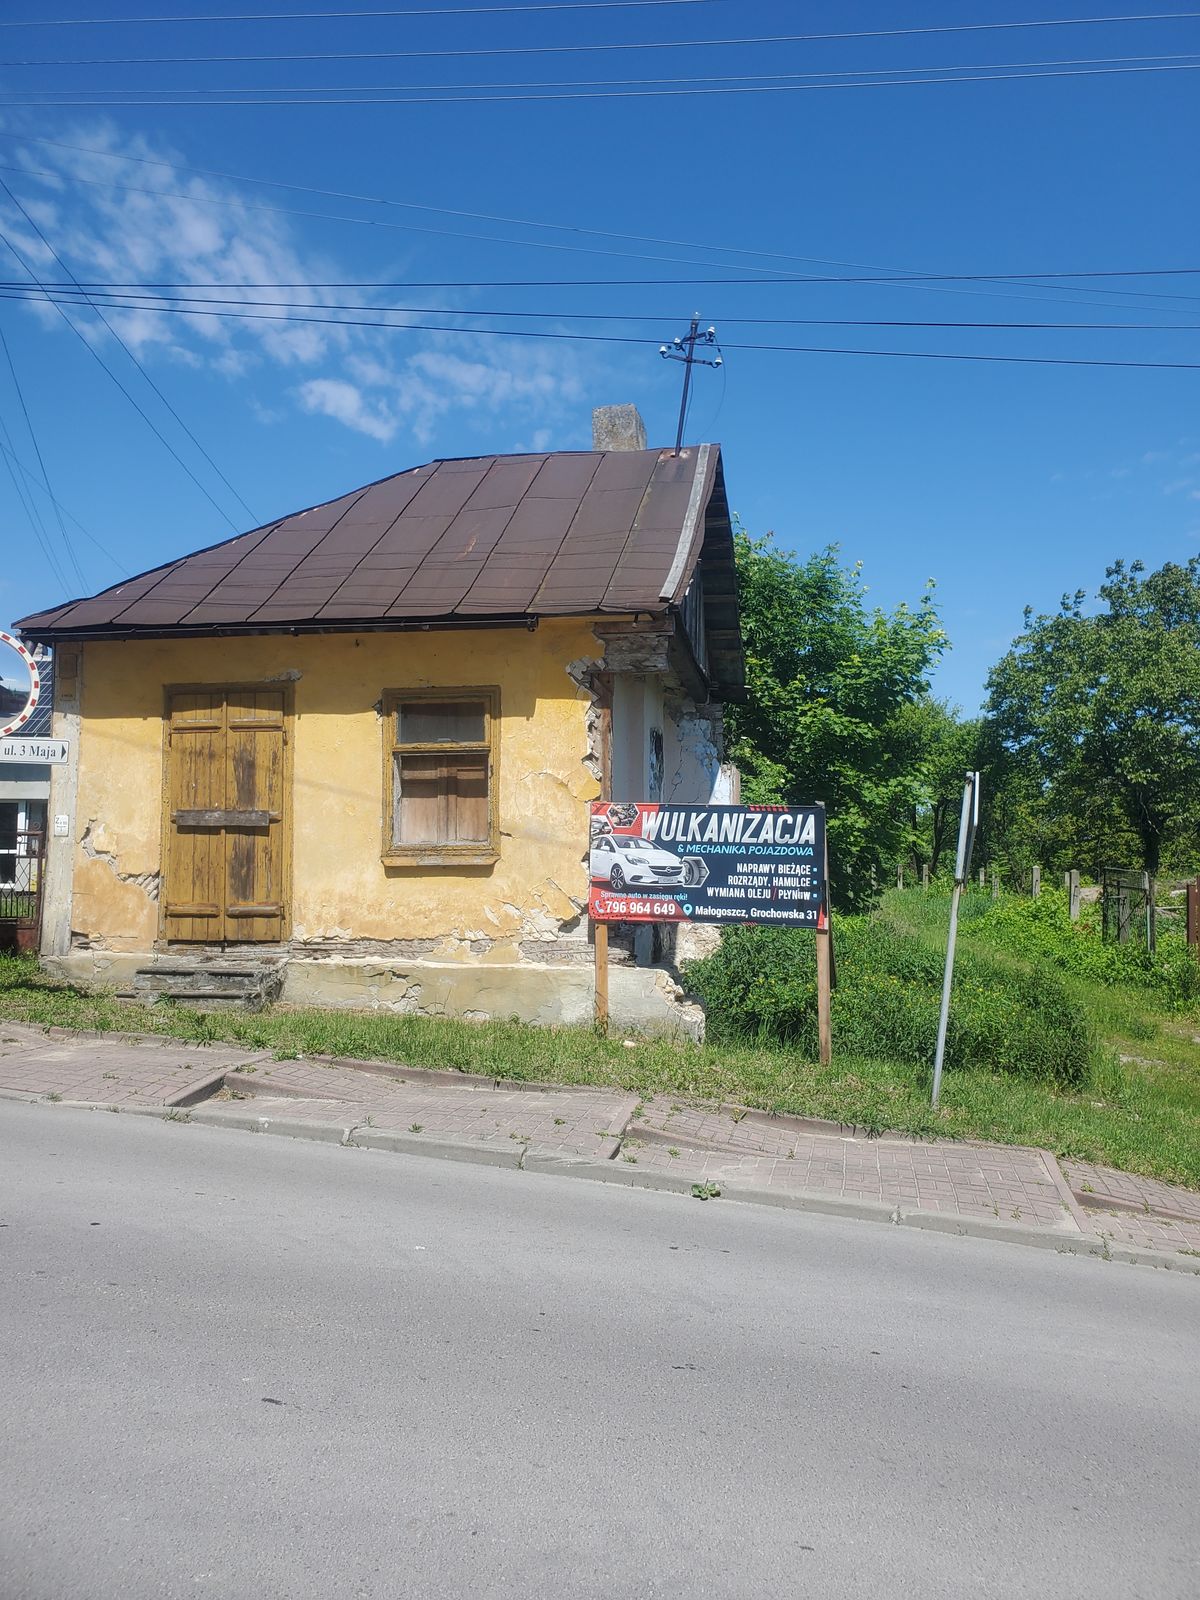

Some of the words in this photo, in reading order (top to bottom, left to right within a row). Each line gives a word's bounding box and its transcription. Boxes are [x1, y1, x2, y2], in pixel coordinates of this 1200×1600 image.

[4, 745, 16, 755] ul.
[20, 745, 26, 756] 3
[29, 745, 56, 760] Maja
[641, 811, 815, 844] WULKANIZACJA
[677, 844, 684, 853] &
[686, 844, 746, 854] MECHANIKA
[748, 845, 814, 856] POJAZDOWA
[736, 863, 776, 874] NAPRAWY
[778, 863, 811, 876] BIEŻĄCE
[773, 877, 811, 887] HAMULCE
[649, 893, 673, 902] zasięgu
[674, 893, 688, 902] ręki!
[707, 887, 745, 898] WYMIANA
[748, 889, 771, 899] OLEJU
[605, 901, 627, 913] 796
[629, 902, 650, 914] 964
[653, 903, 676, 915] 649
[695, 905, 748, 918] Małogoszcz,
[750, 908, 804, 919] Grochowska
[806, 910, 817, 920] 31
